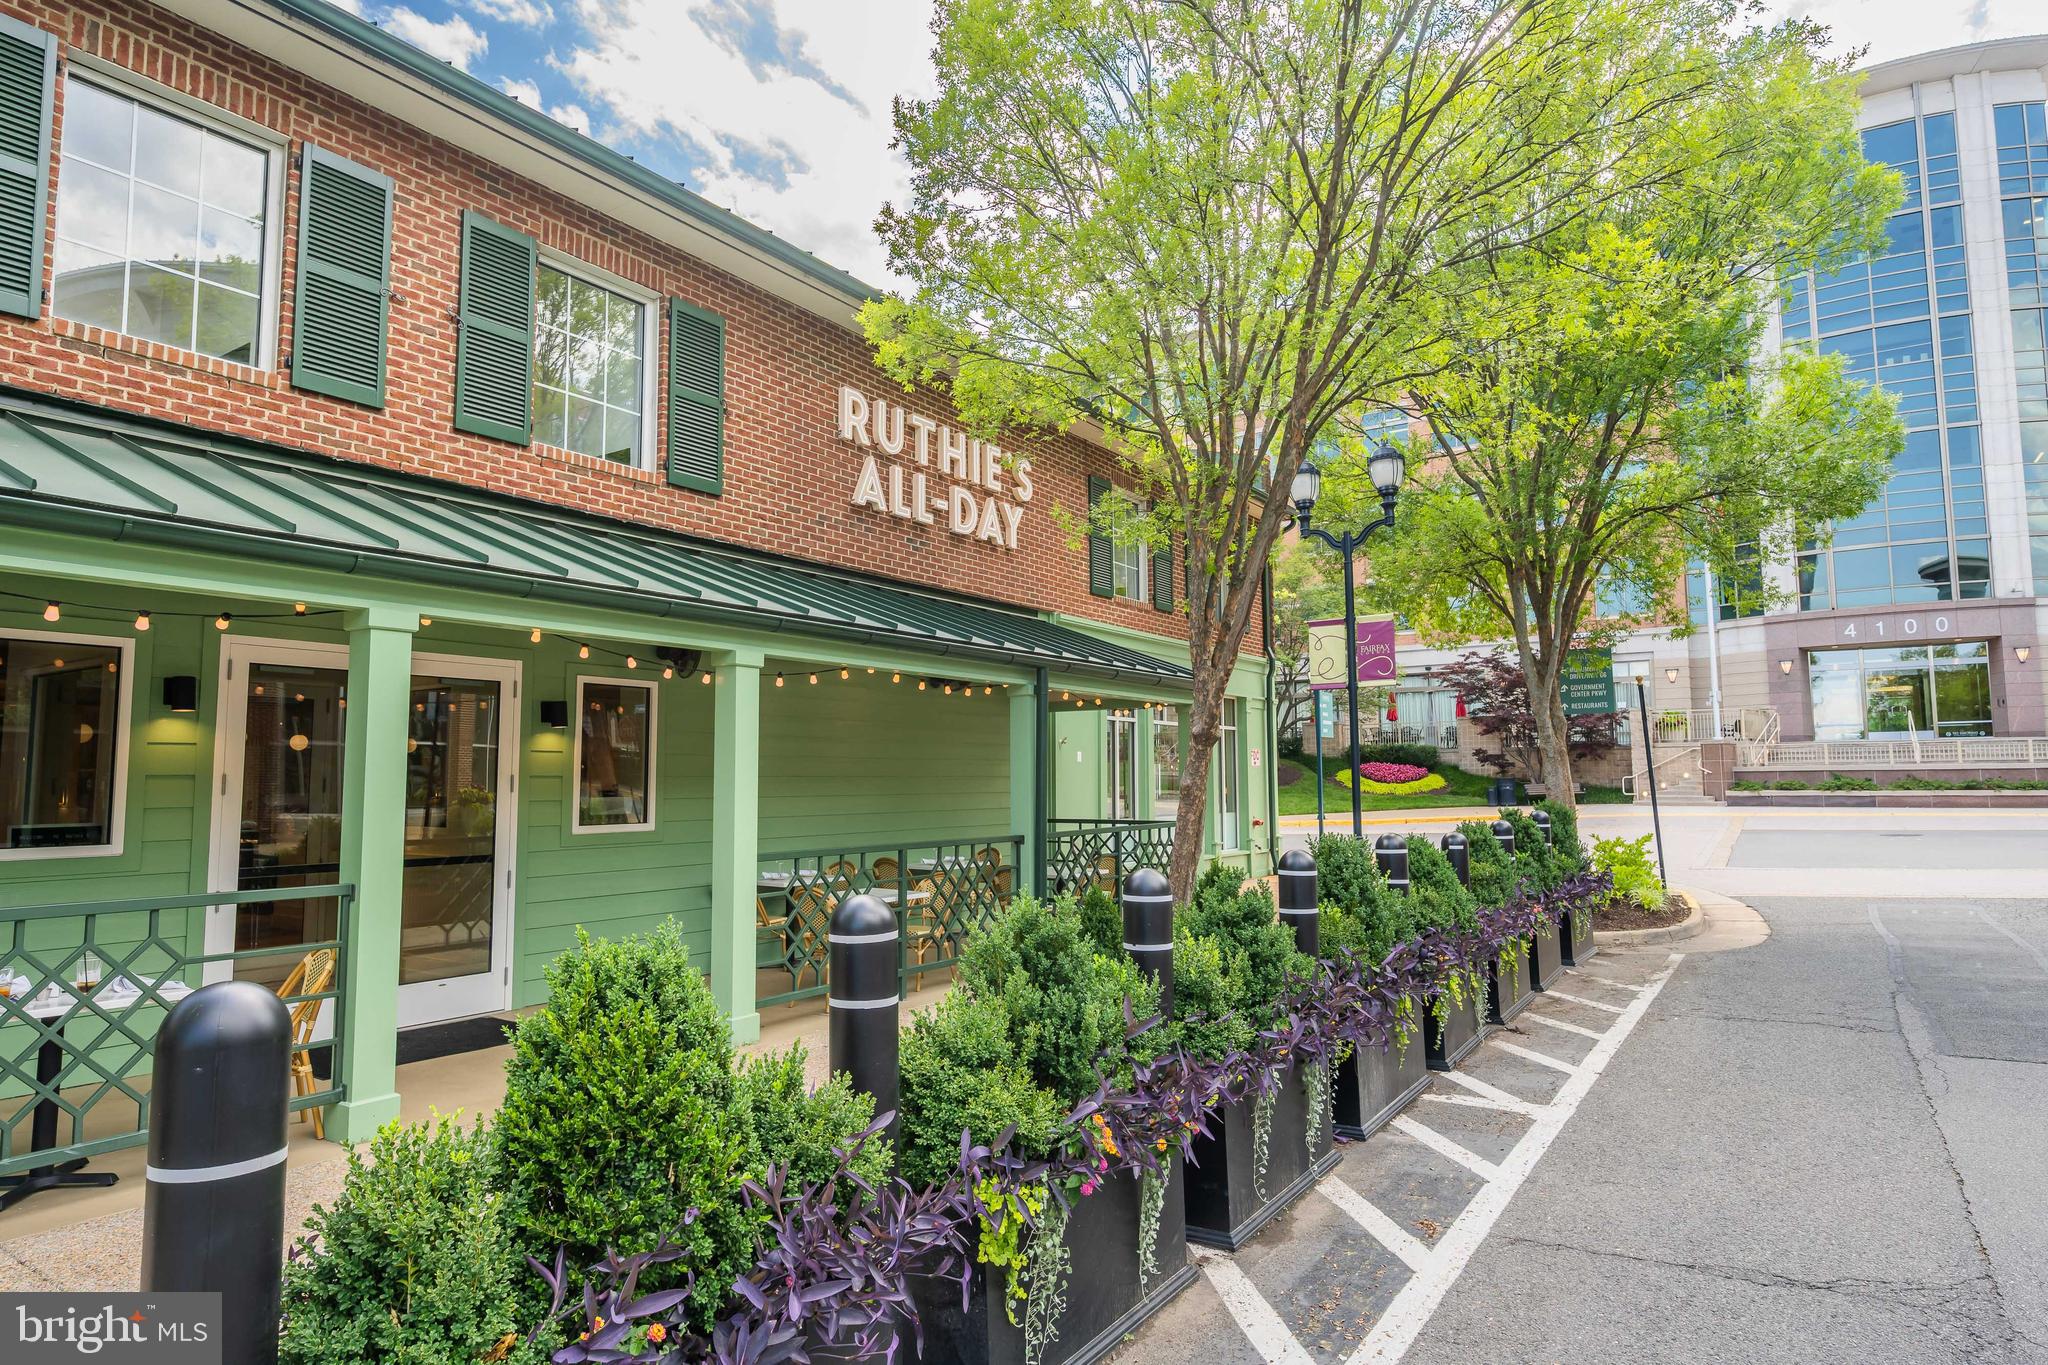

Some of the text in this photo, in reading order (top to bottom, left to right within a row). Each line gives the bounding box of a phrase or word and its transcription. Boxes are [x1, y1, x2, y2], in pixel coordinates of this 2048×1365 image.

[851, 455, 1024, 549] ALL-DAY
[1844, 616, 1949, 638] 4100
[1360, 643, 1390, 653] FAIRFAX
